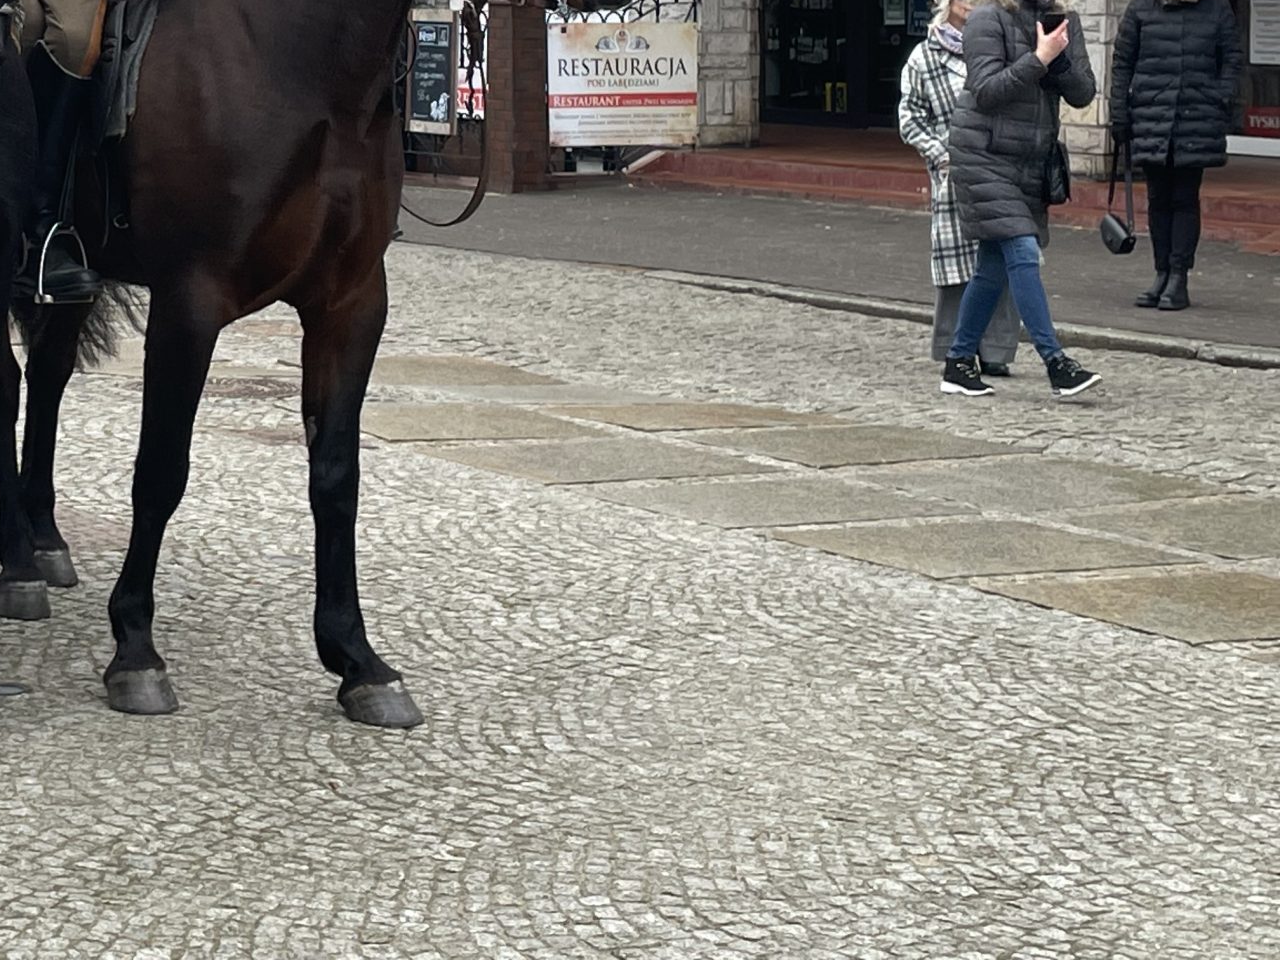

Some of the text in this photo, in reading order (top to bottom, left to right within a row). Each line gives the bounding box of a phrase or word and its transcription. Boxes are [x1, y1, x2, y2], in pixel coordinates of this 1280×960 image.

[558, 57, 688, 80] RESTAURACJA
[587, 79, 606, 87] POD
[553, 96, 620, 107] RESTAURANT
